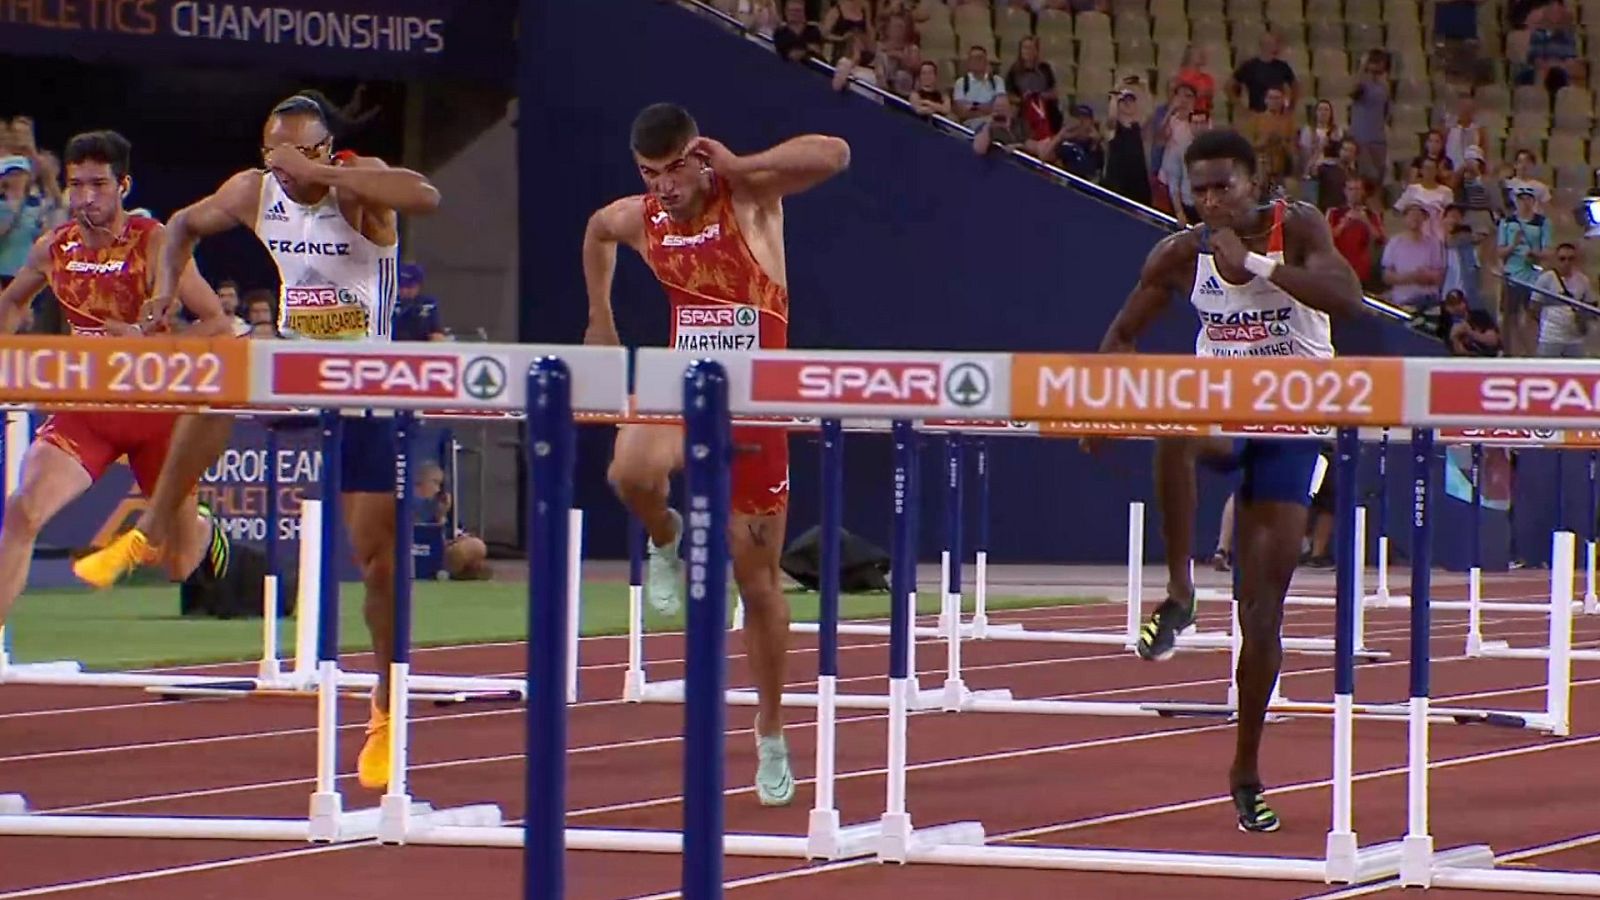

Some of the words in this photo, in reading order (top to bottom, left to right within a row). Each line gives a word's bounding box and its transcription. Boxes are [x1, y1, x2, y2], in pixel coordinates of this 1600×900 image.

[171, 1, 444, 53] CHAMPIONSHIPS
[268, 240, 350, 256] FRANCE
[286, 290, 336, 305] SPAR
[680, 309, 733, 324] SPAR
[1201, 307, 1292, 325] FRANCE
[1207, 325, 1267, 340] SPAR
[108, 352, 221, 392] 2022
[318, 358, 456, 391] SPAR
[797, 365, 937, 400] SPAR
[1037, 366, 1233, 410] MUNICH
[1252, 369, 1373, 413] 2022
[1480, 377, 1600, 412] SPA
